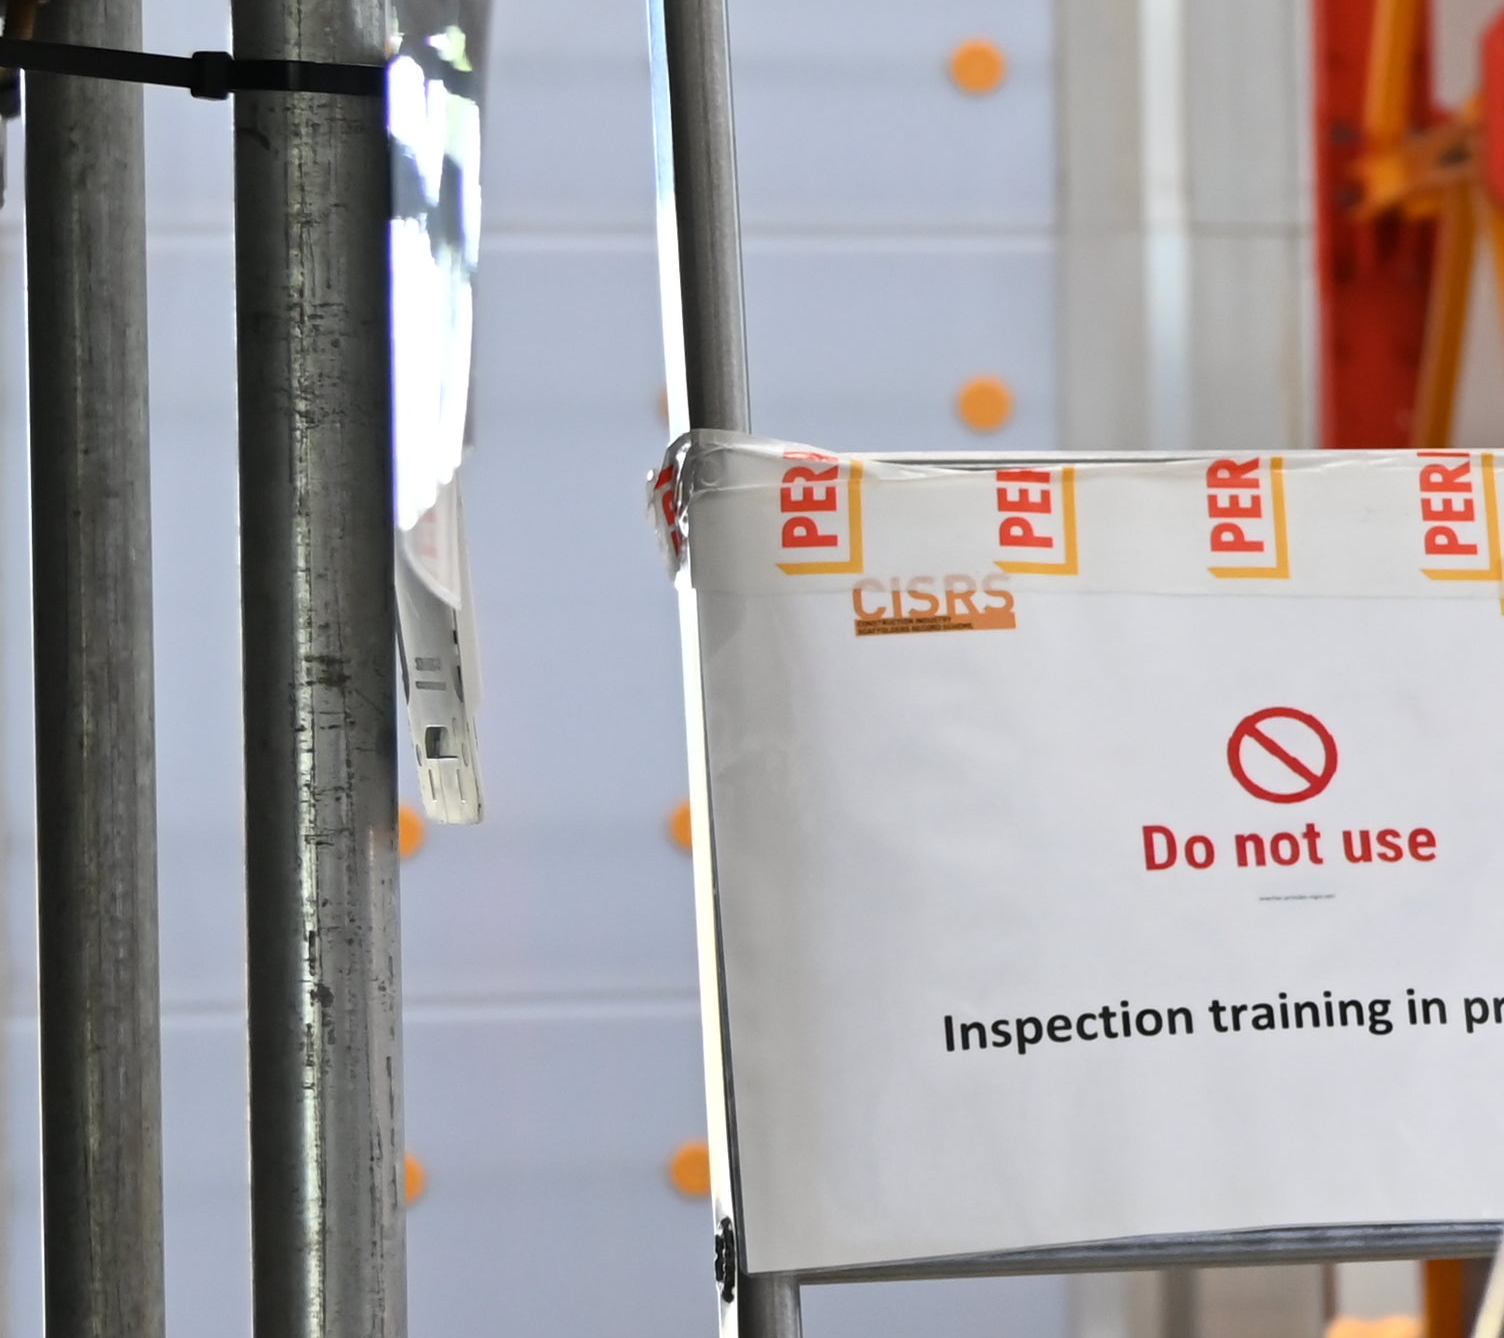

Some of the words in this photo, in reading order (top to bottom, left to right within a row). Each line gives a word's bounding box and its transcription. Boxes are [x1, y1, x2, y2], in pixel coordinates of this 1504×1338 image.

[852, 573, 1015, 619] CISRS
[1142, 825, 1215, 871] Do
[1234, 822, 1324, 868] not
[1342, 827, 1437, 863] use
[944, 1000, 1194, 1055] Inspection
[1208, 991, 1394, 1036] training
[1406, 988, 1447, 1025] in
